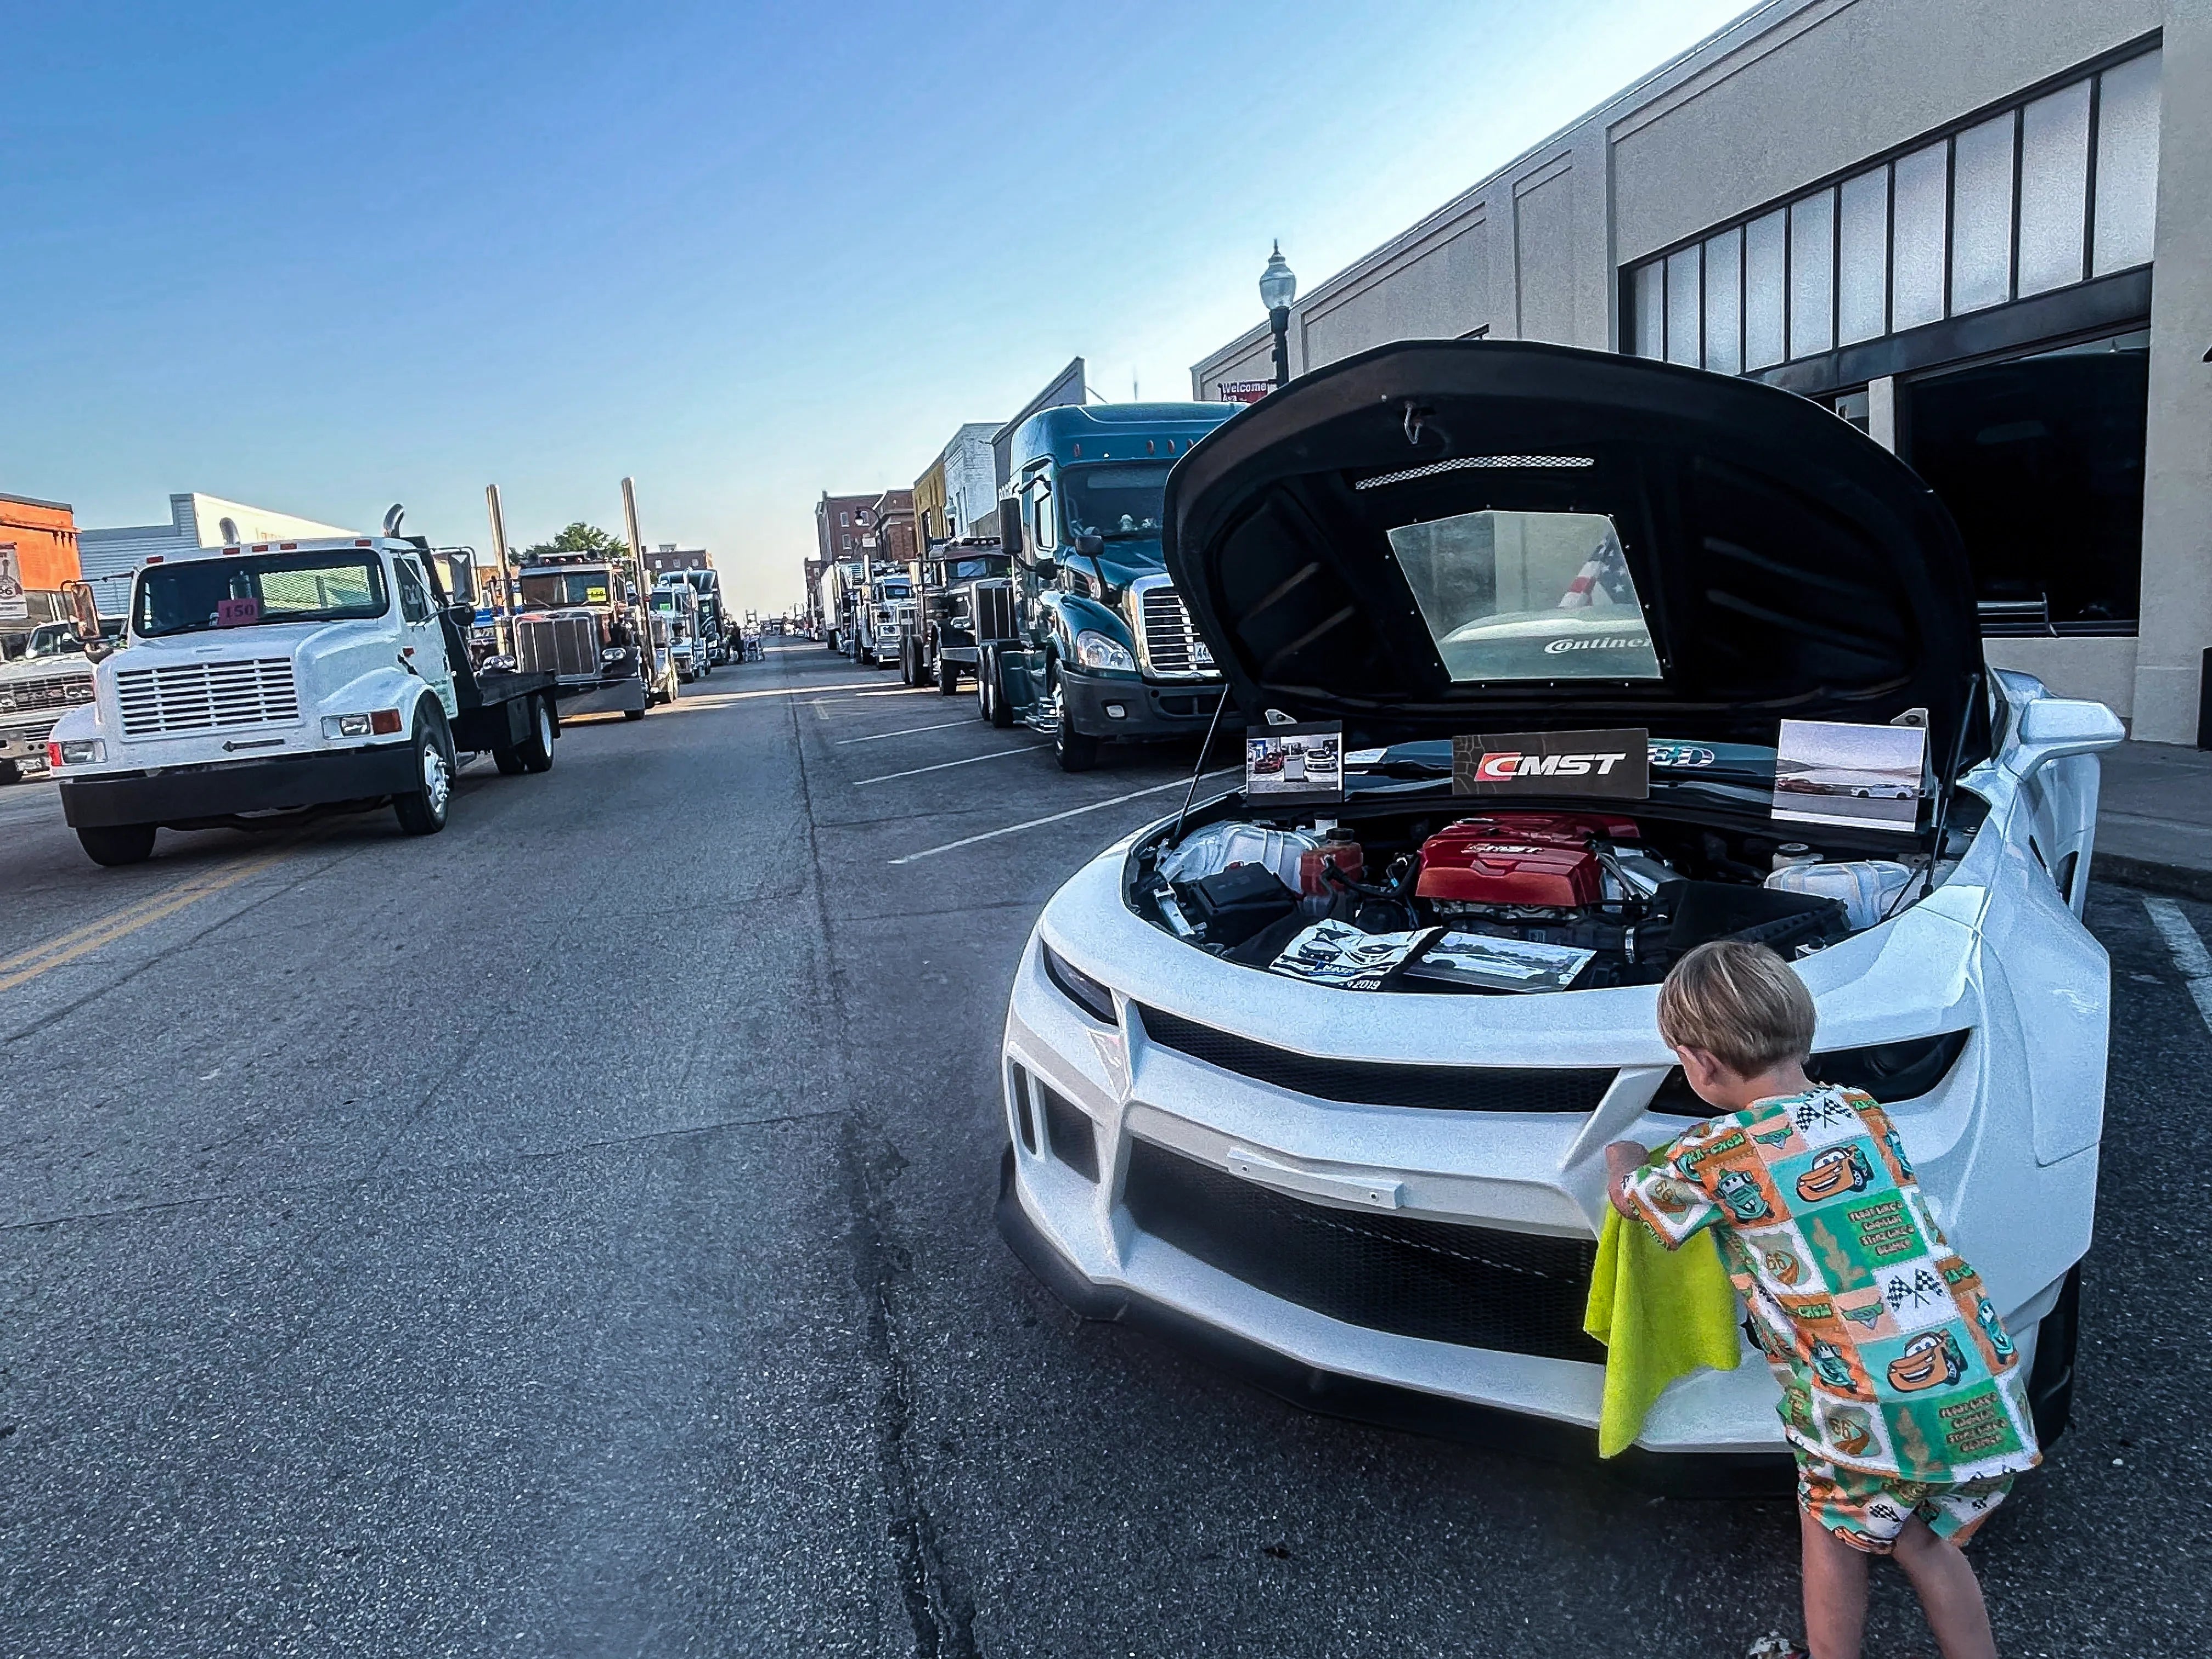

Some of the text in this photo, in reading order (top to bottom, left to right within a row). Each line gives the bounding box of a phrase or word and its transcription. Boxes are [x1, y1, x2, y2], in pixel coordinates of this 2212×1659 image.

[1223, 382, 1266, 393] Welcome
[226, 604, 255, 618] 150
[1482, 752, 1627, 777] CMST
[1647, 746, 1716, 768] ED
